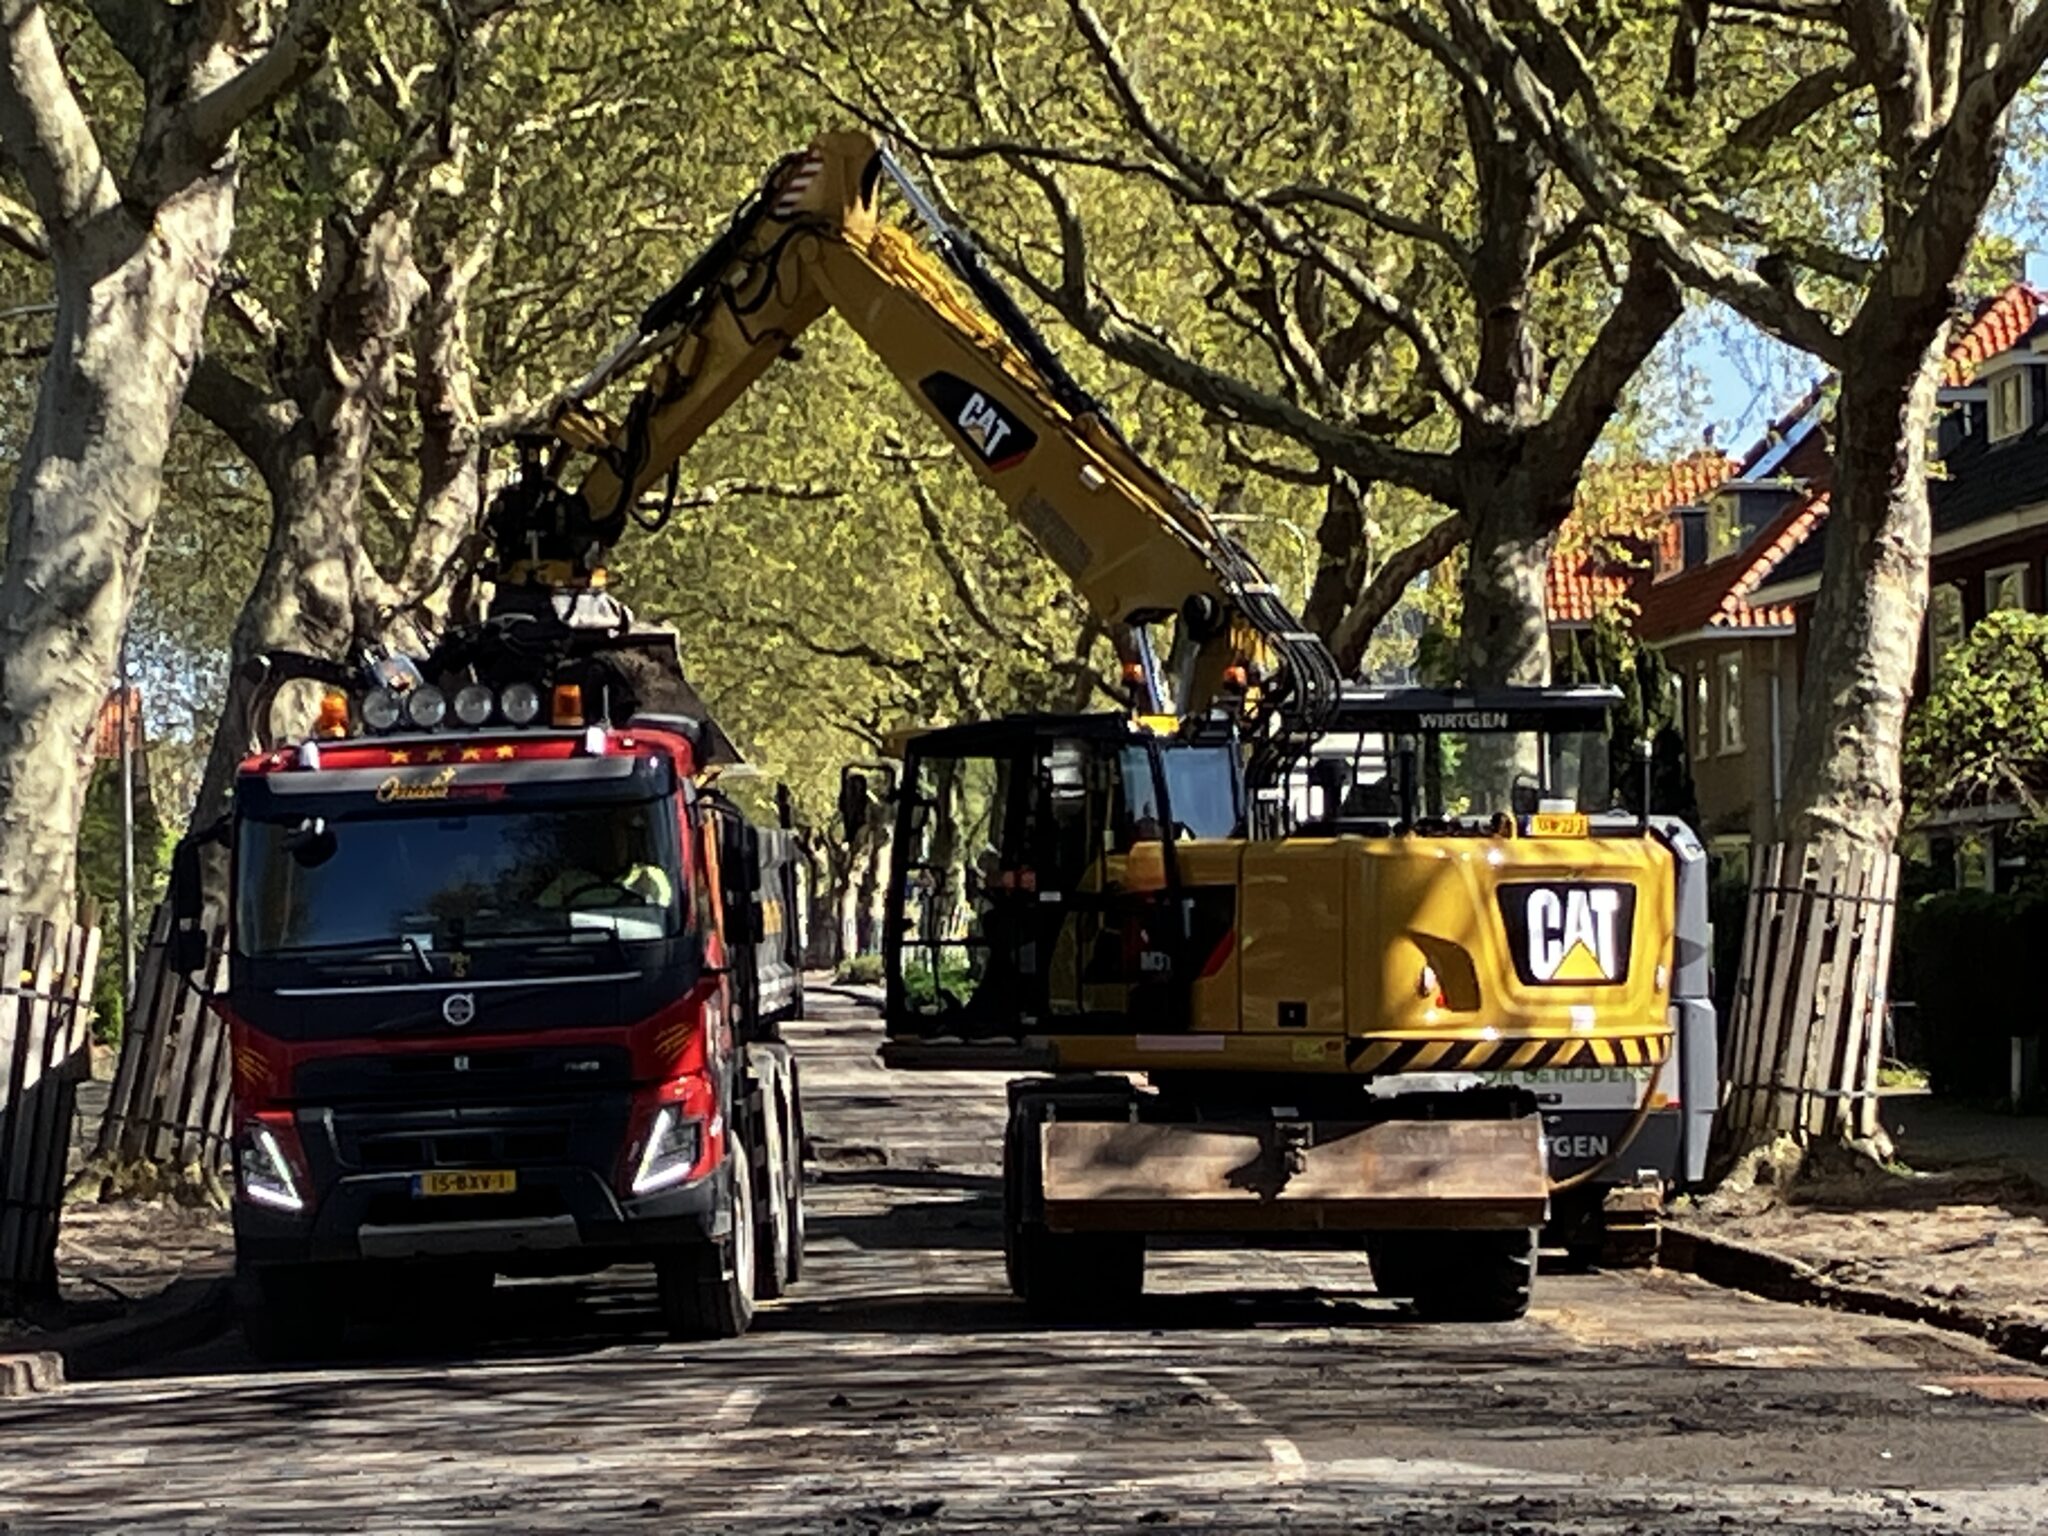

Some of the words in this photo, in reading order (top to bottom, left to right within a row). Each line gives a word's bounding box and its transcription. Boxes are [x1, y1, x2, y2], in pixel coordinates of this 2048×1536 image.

[958, 392, 1011, 457] CAT
[1418, 711, 1508, 729] WIRTGEN
[1526, 888, 1620, 980] CAT
